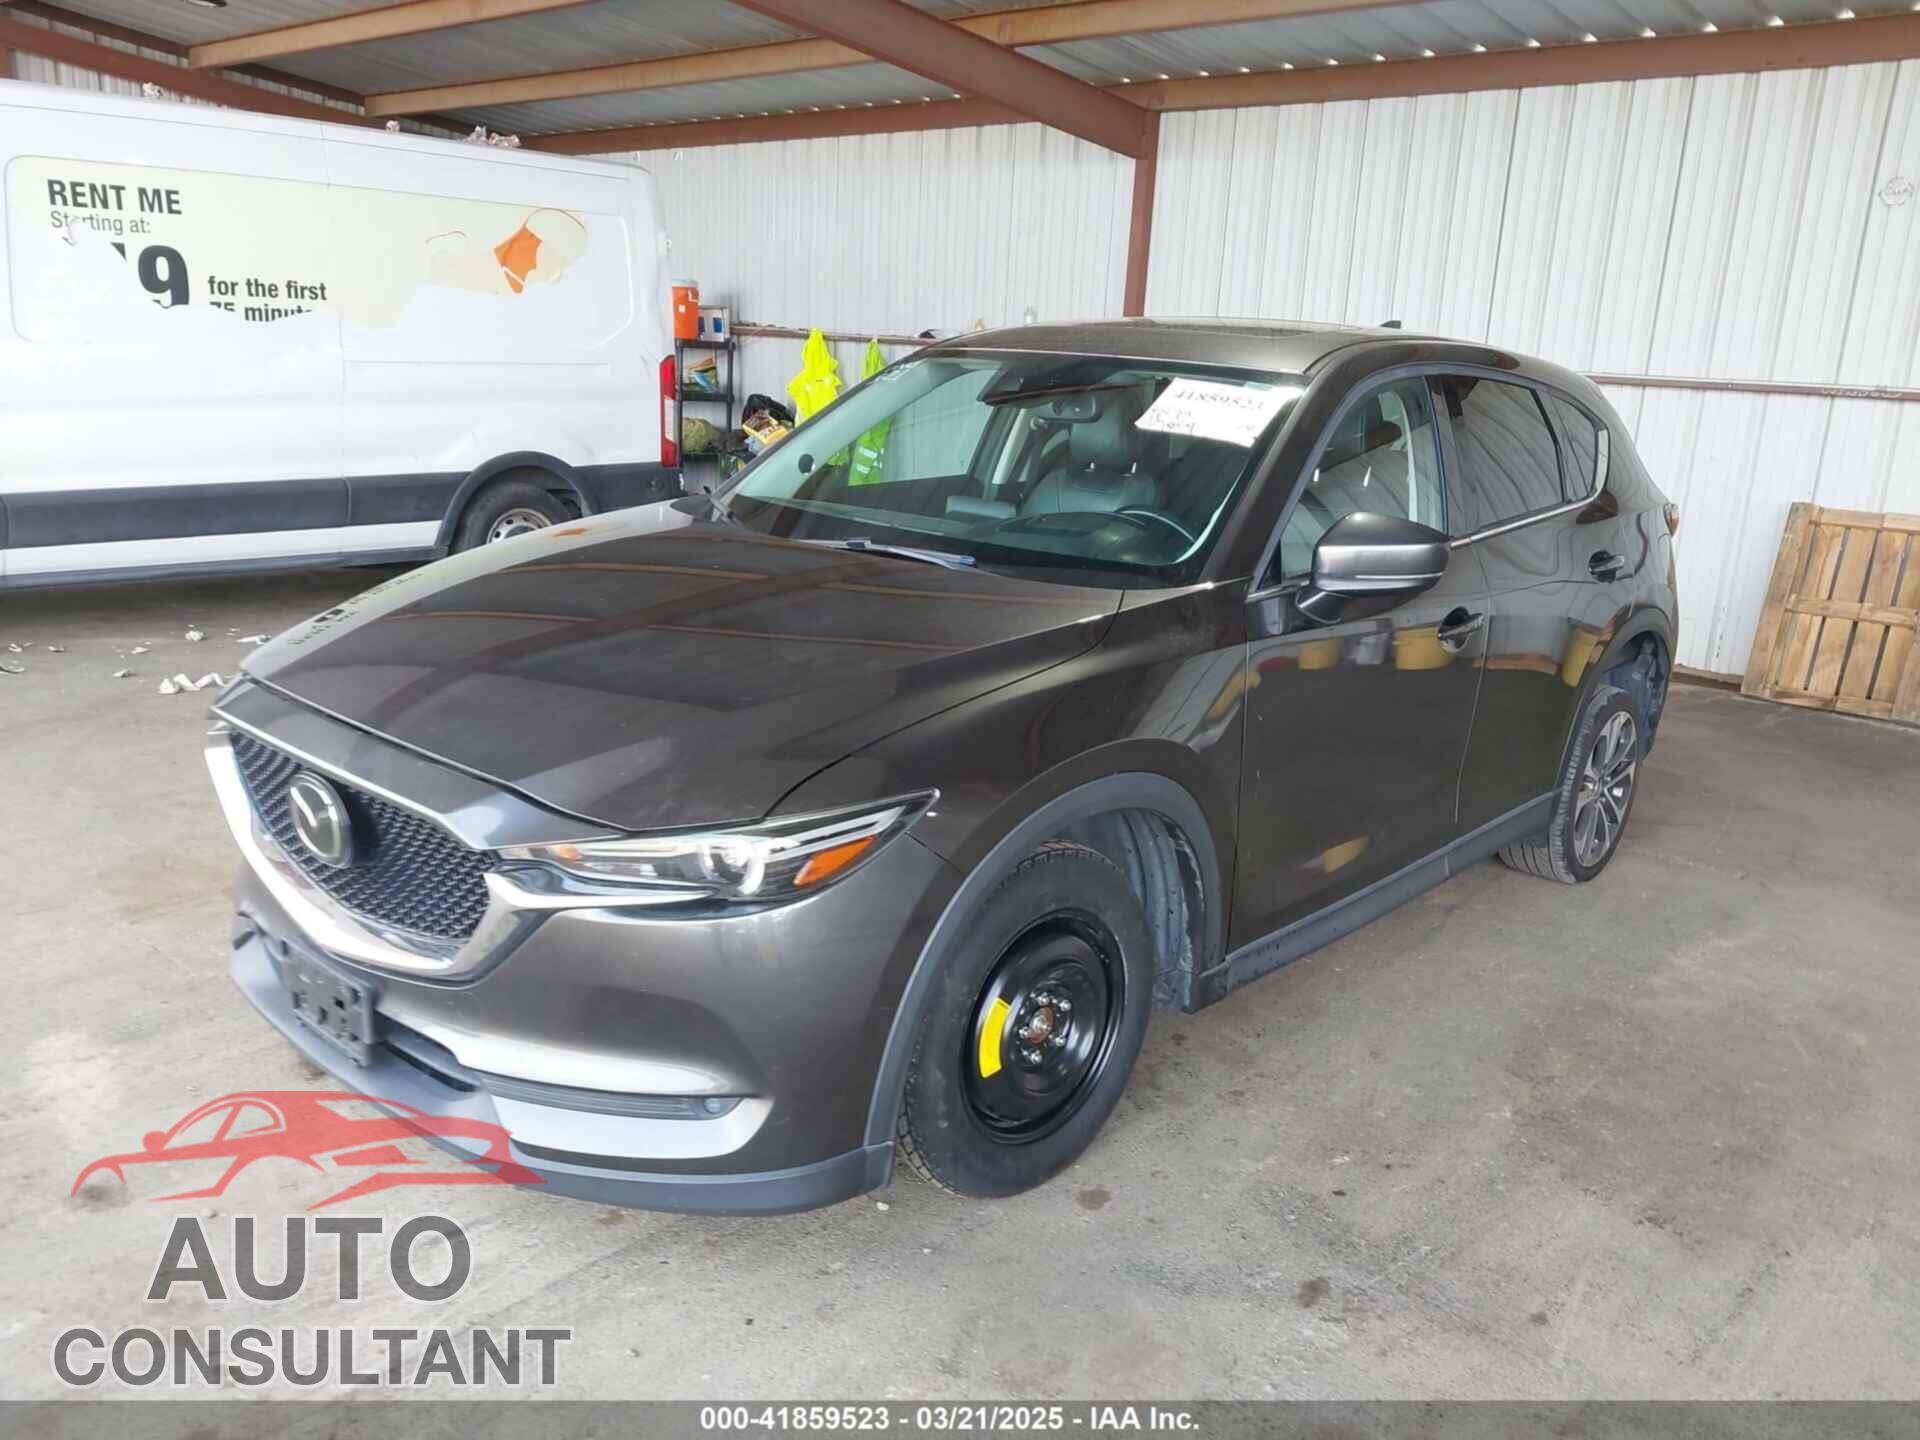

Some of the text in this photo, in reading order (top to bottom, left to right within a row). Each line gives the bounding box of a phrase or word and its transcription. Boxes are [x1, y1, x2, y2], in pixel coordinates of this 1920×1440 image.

[47, 179, 182, 215] RENT ME
[50, 210, 151, 236] Strting at:
[208, 275, 328, 301] for the first
